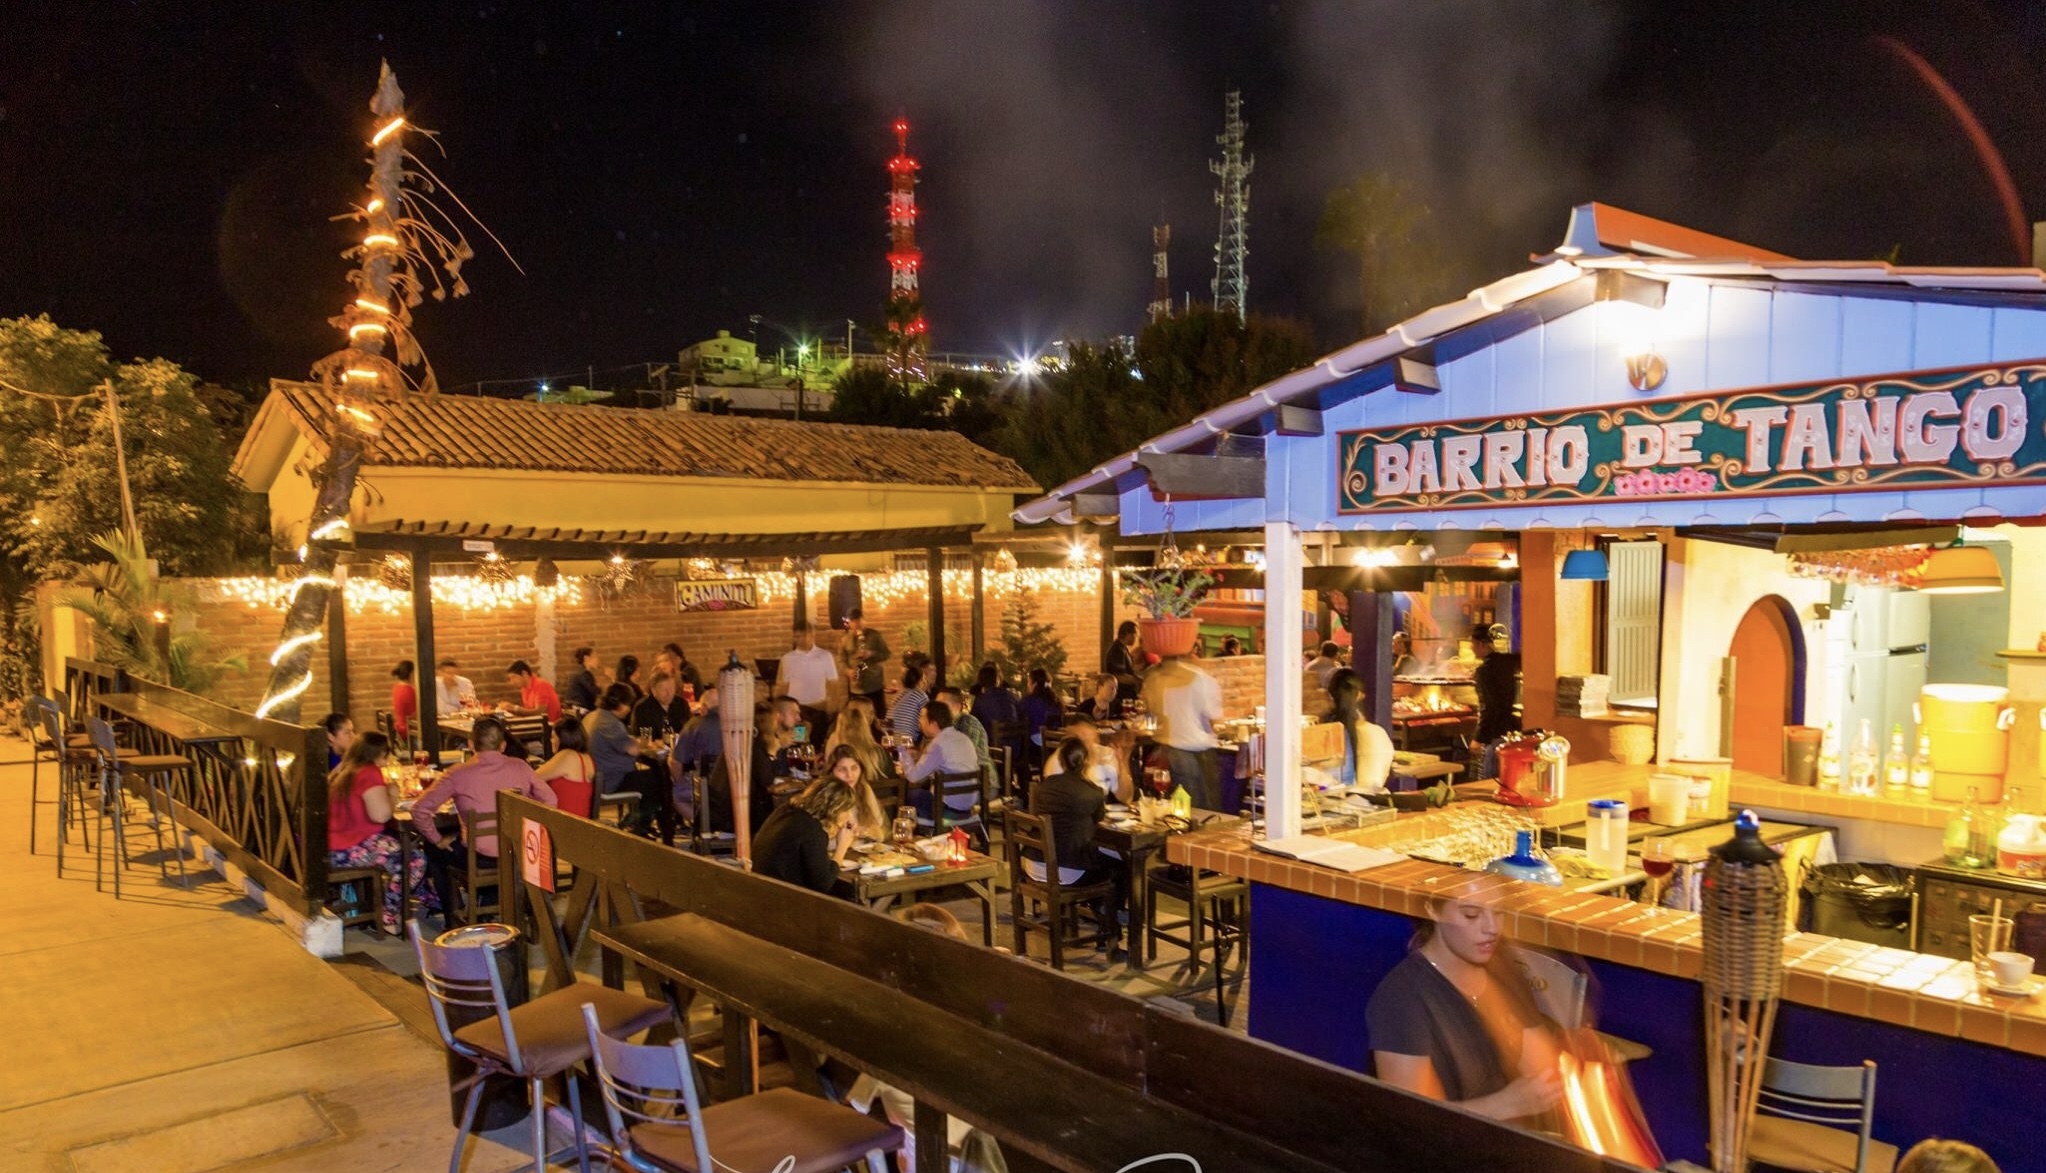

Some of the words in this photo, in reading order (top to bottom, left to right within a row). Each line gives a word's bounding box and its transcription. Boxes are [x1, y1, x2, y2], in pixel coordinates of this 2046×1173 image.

[1372, 425, 1589, 497] BARRIO
[1621, 420, 1704, 467] DE
[1731, 386, 2029, 473] TANGO
